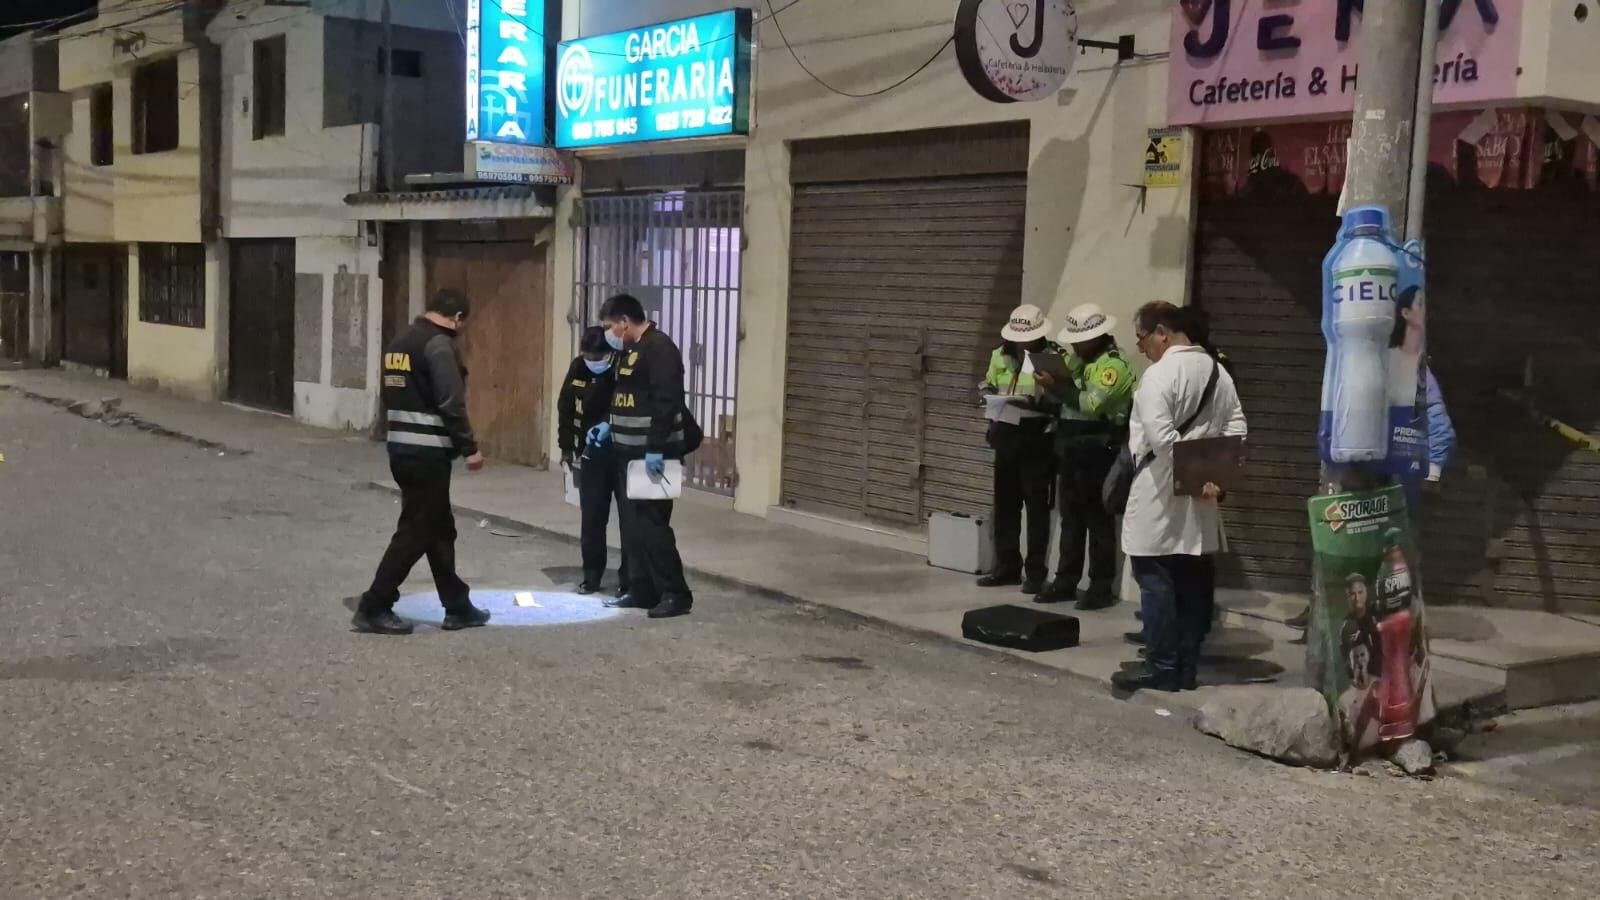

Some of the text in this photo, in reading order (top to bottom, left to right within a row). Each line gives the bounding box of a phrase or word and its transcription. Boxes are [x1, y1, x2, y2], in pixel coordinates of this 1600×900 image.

[625, 22, 701, 64] GARCIA
[594, 57, 735, 112] FUNERARIA
[1189, 71, 1297, 106] Cafetería
[1308, 67, 1328, 96] &
